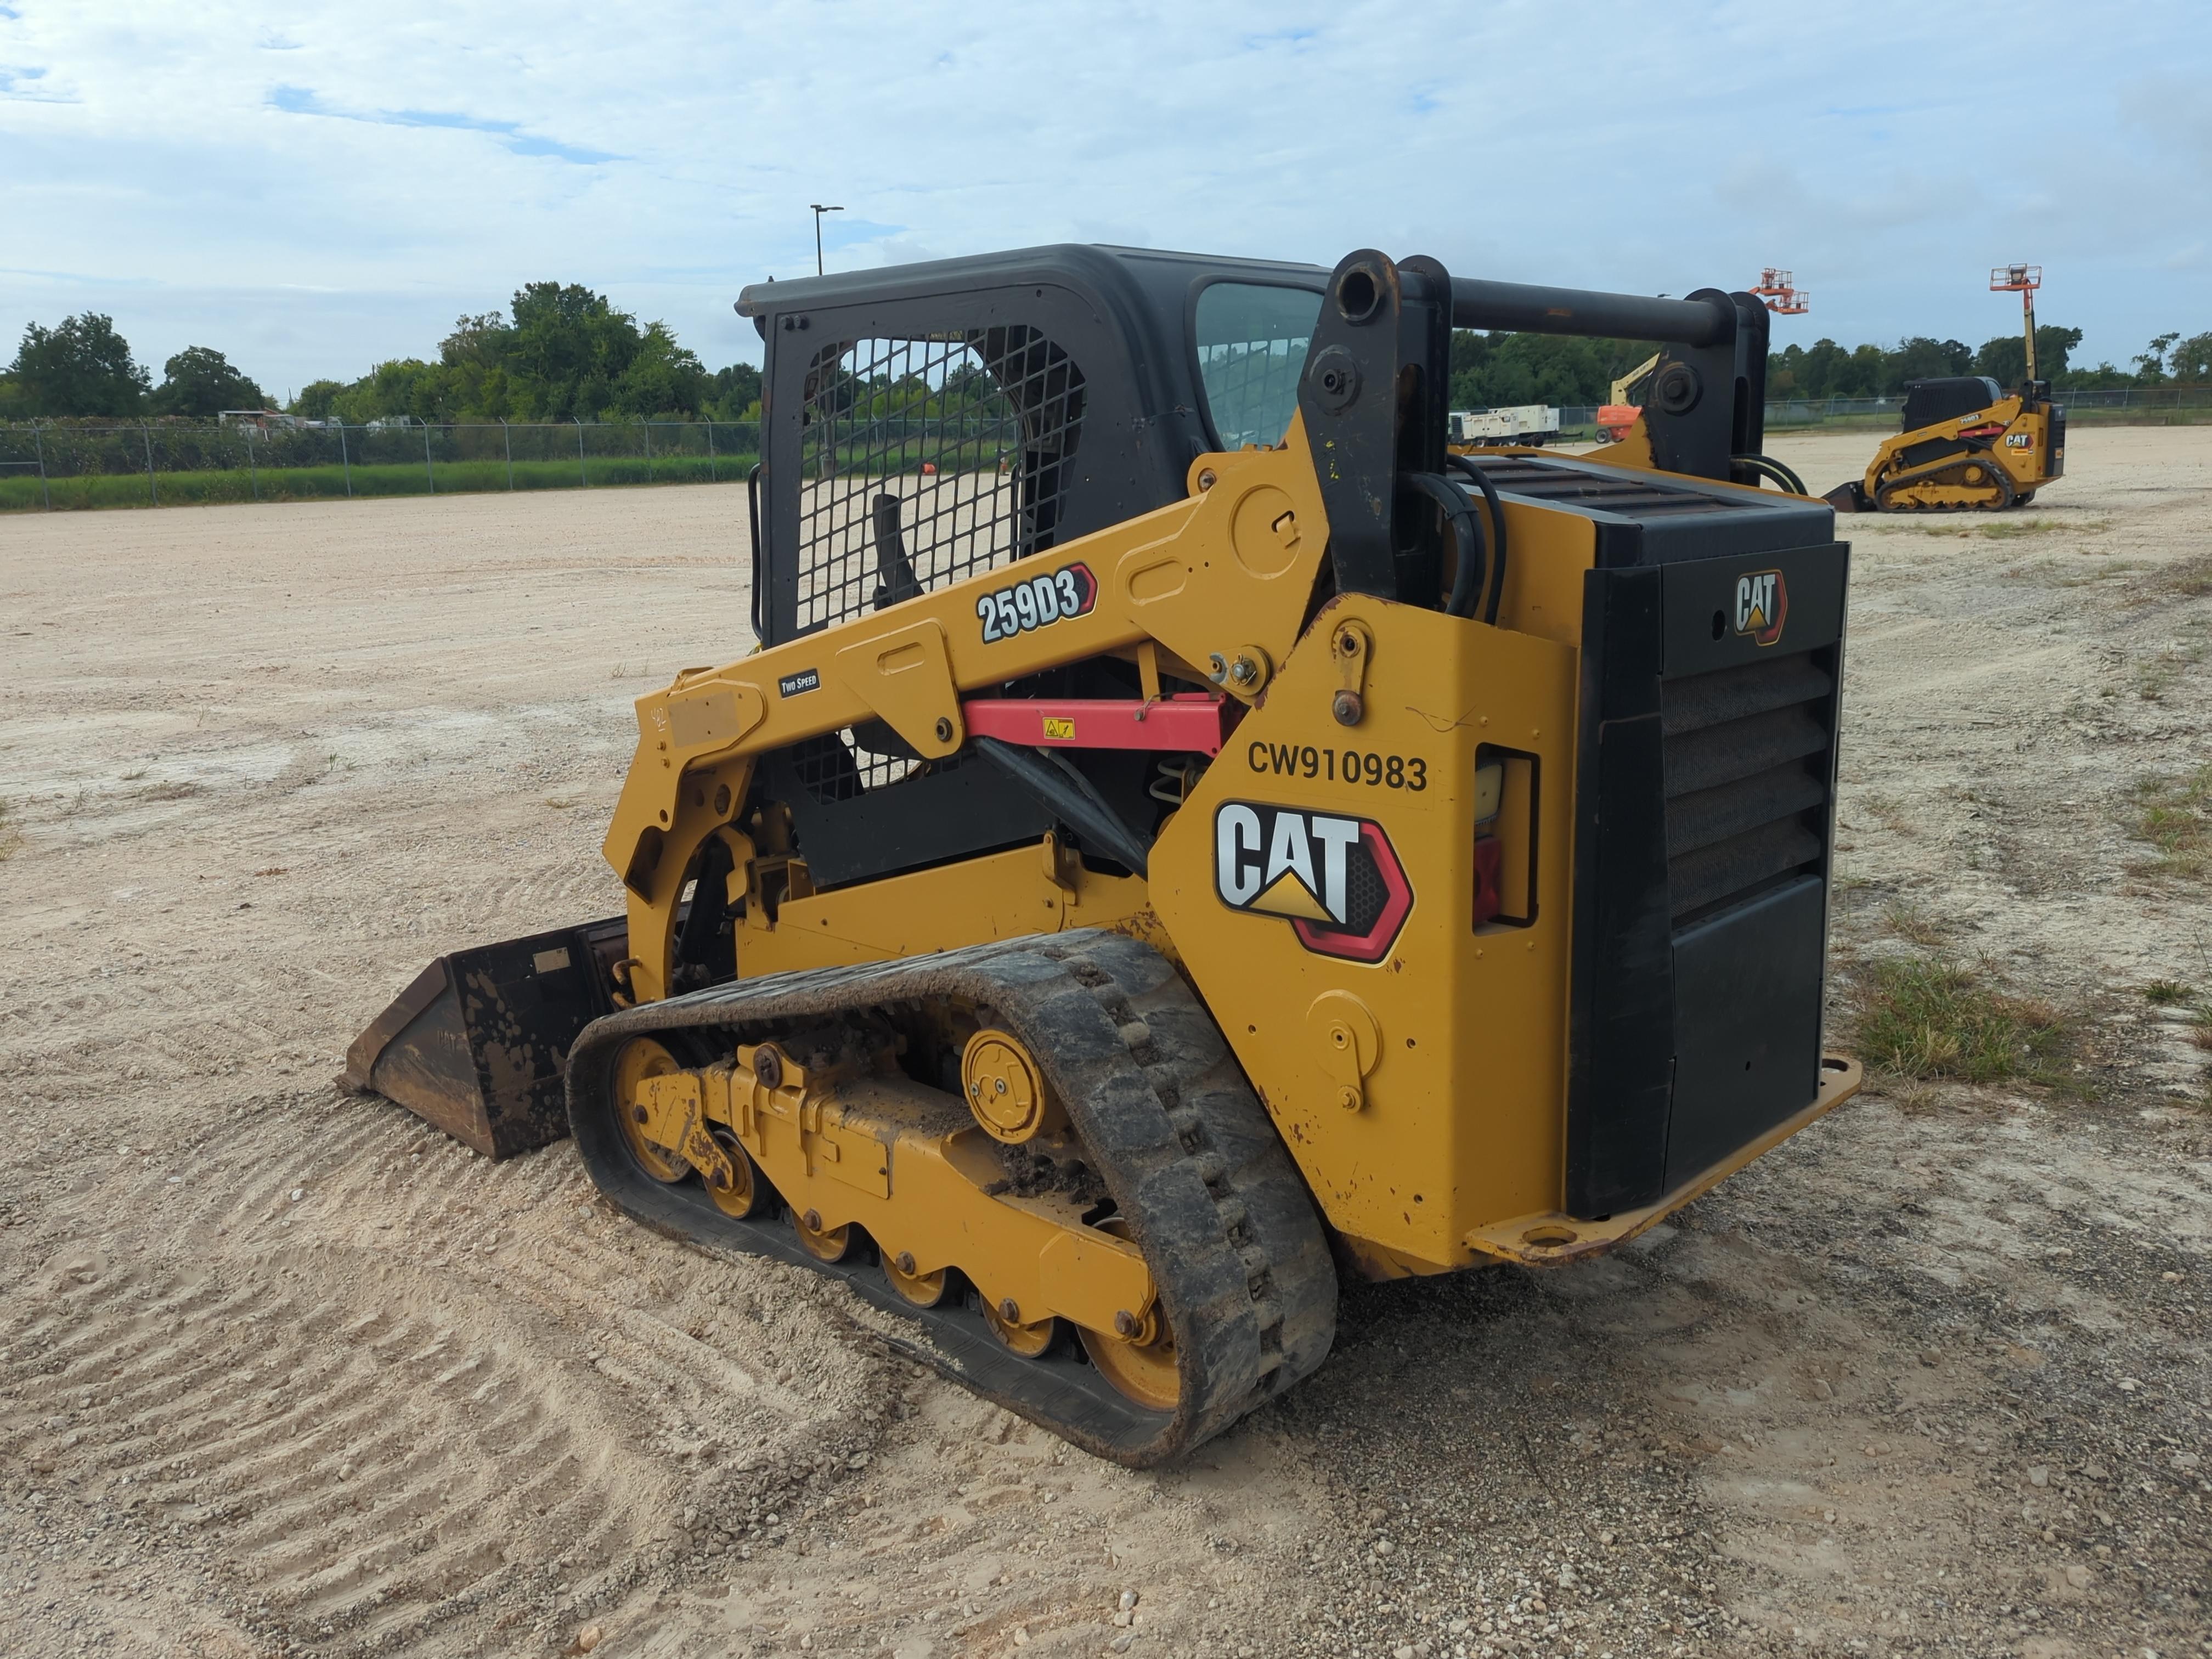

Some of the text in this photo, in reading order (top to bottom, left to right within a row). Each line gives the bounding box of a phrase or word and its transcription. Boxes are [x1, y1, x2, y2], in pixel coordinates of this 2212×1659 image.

[2006, 435, 2028, 447] CAT
[978, 570, 1079, 641] 259D3
[1736, 574, 1775, 631] CAT
[1248, 741, 1427, 791] CW910983
[1217, 804, 1359, 924] CAT
